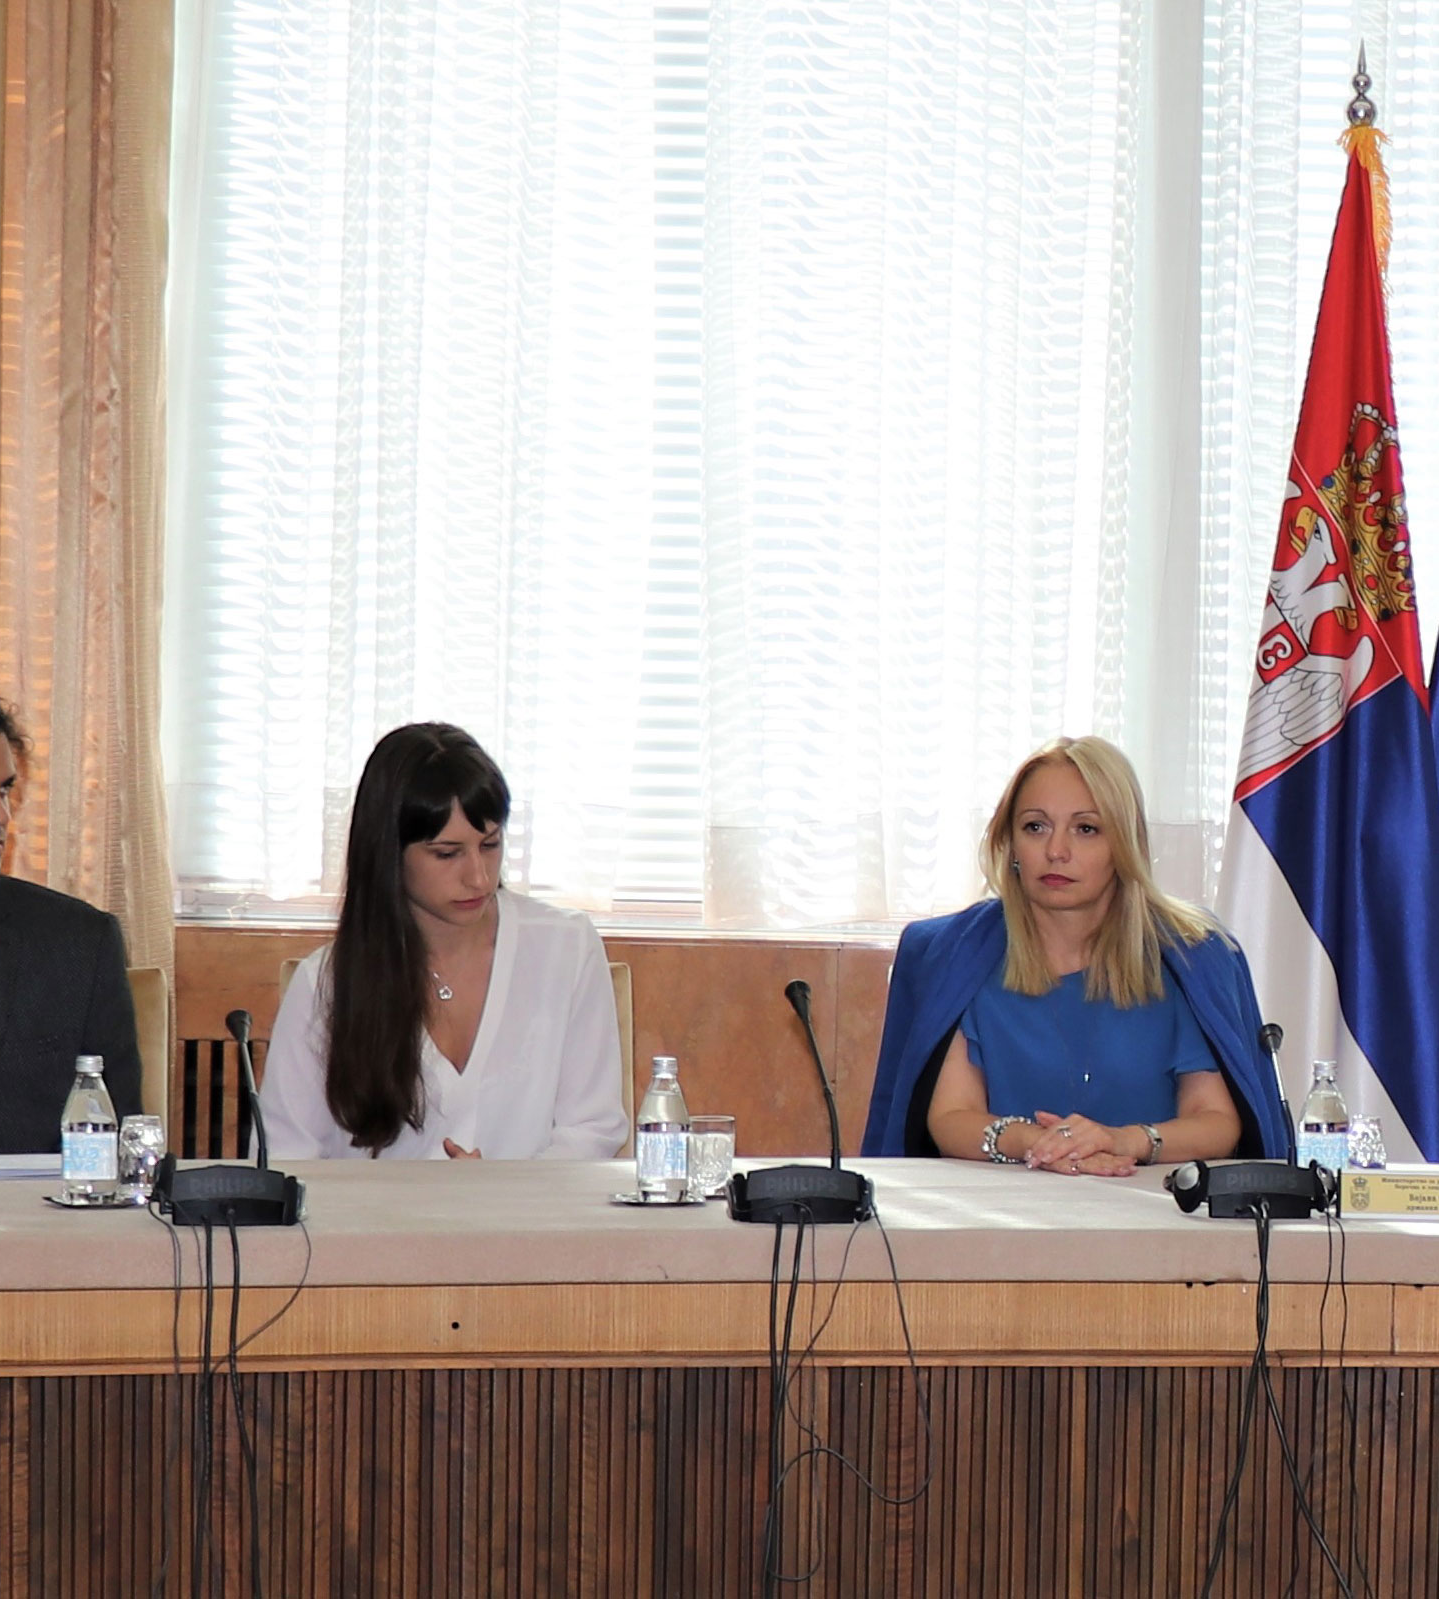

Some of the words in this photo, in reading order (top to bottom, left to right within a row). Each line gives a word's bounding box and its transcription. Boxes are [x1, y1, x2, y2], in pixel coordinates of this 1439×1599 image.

[189, 1176, 266, 1193] PHILIPS
[765, 1176, 840, 1193] PHILIPS
[1226, 1172, 1298, 1188] PHILIPS
